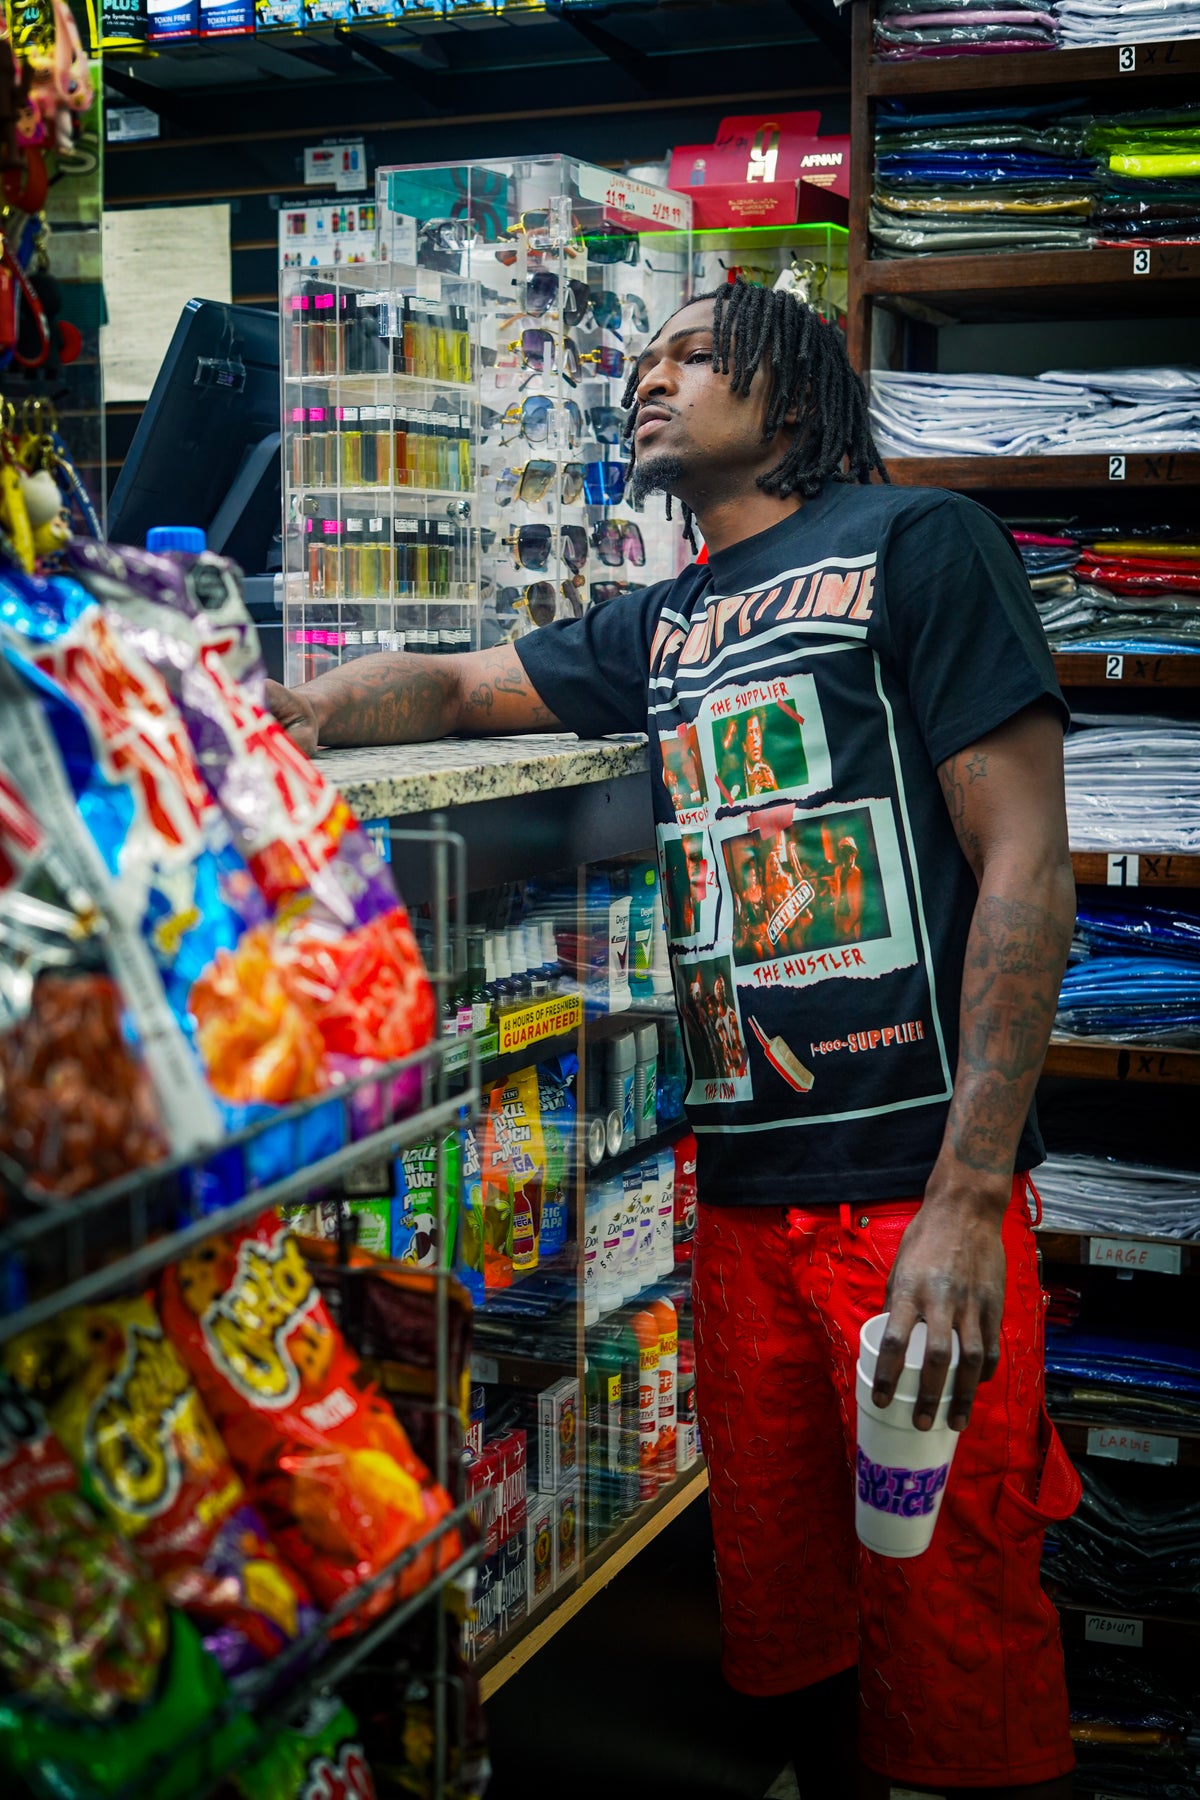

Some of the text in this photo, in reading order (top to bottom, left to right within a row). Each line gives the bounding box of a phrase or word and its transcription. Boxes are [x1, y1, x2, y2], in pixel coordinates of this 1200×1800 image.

[174, 13, 191, 22] FREE
[227, 14, 245, 23] FREE
[1121, 47, 1133, 69] 3
[800, 153, 842, 167] AFNAN
[1135, 250, 1149, 272] 3
[1110, 457, 1123, 479] 2
[775, 565, 877, 621] LINE
[1107, 656, 1120, 678] 2
[710, 681, 790, 717] THE SUPPLIER
[1112, 855, 1127, 888] 1
[753, 947, 867, 985] THE HUSTLER
[504, 996, 580, 1031] 48 HOURS OF FRESHNESS
[503, 1009, 579, 1049] GUARANTEED!
[542, 1206, 560, 1219] BIG
[1095, 1246, 1148, 1265] LARGE
[1099, 1434, 1151, 1453] LARGE
[858, 1482, 935, 1517] JUICE
[1088, 1617, 1136, 1636] MEDIUM
